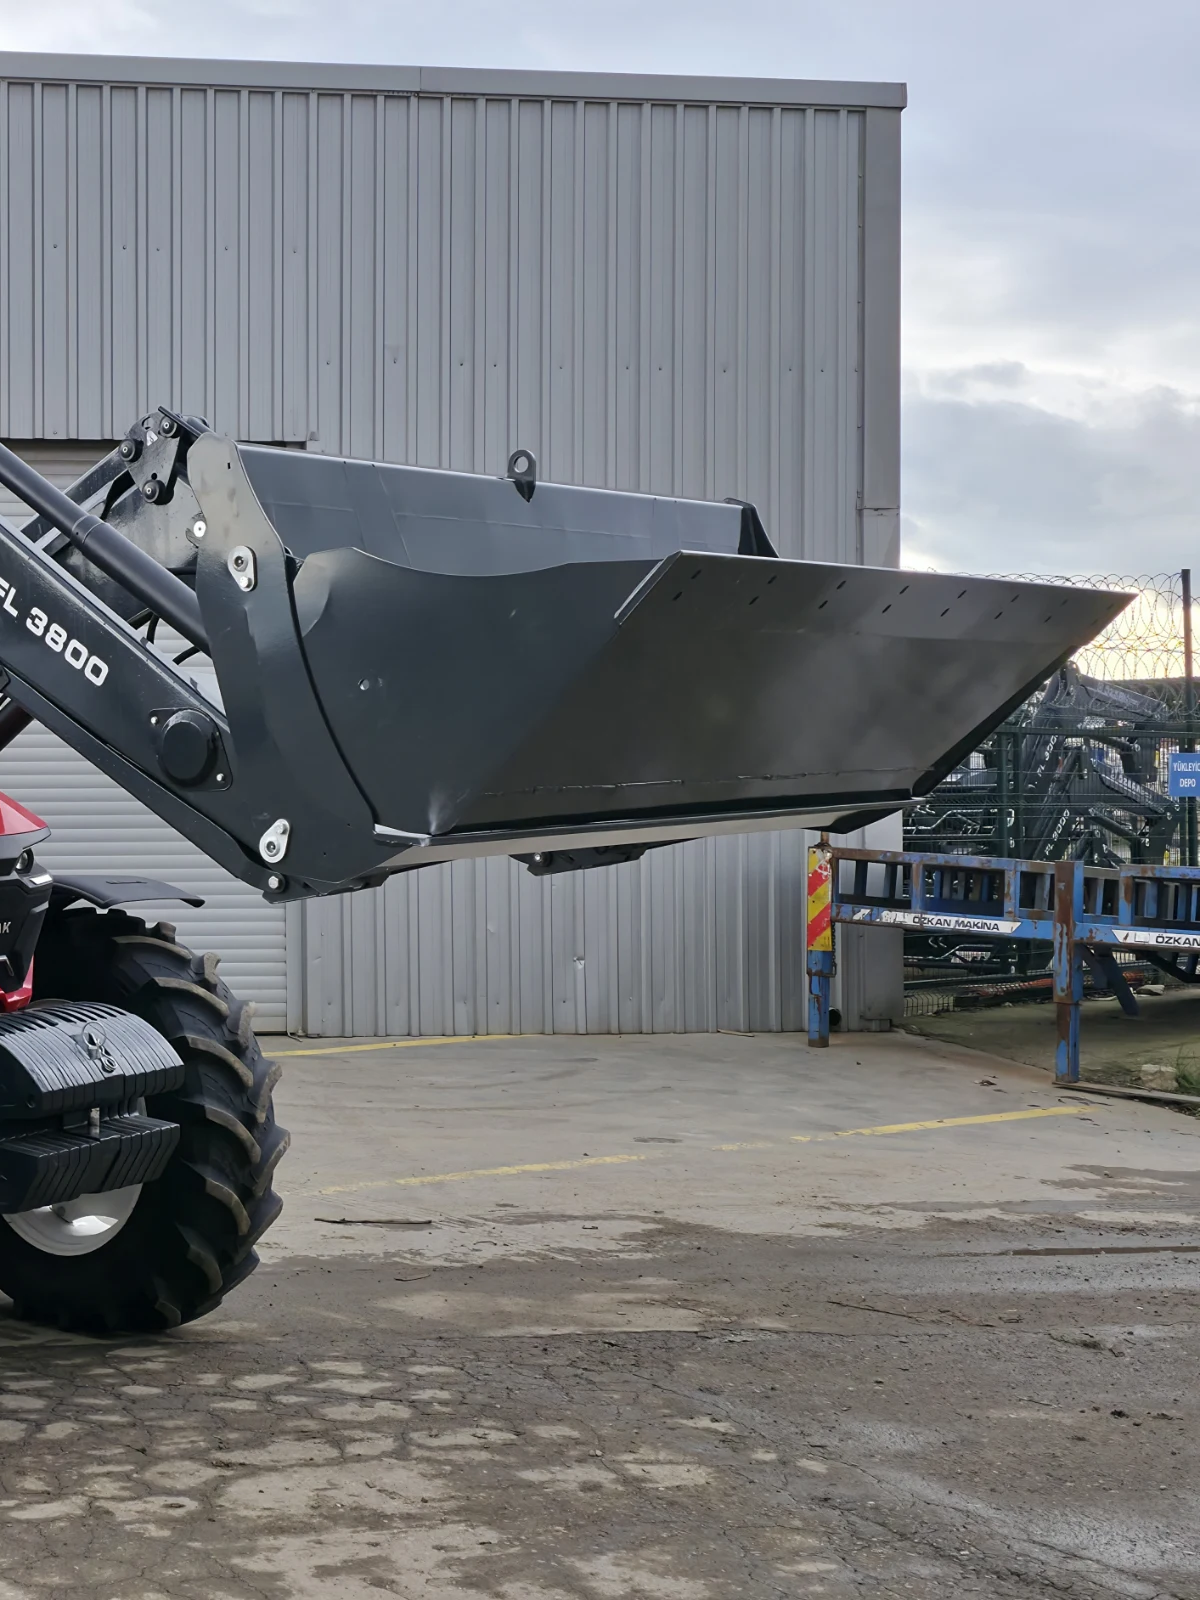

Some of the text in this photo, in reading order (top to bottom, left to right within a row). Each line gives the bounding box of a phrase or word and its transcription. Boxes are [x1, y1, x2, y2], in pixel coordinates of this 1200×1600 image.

[25, 606, 109, 687] 3800
[1179, 778, 1196, 788] DEPO
[1155, 933, 1200, 947] ÖZKAN
